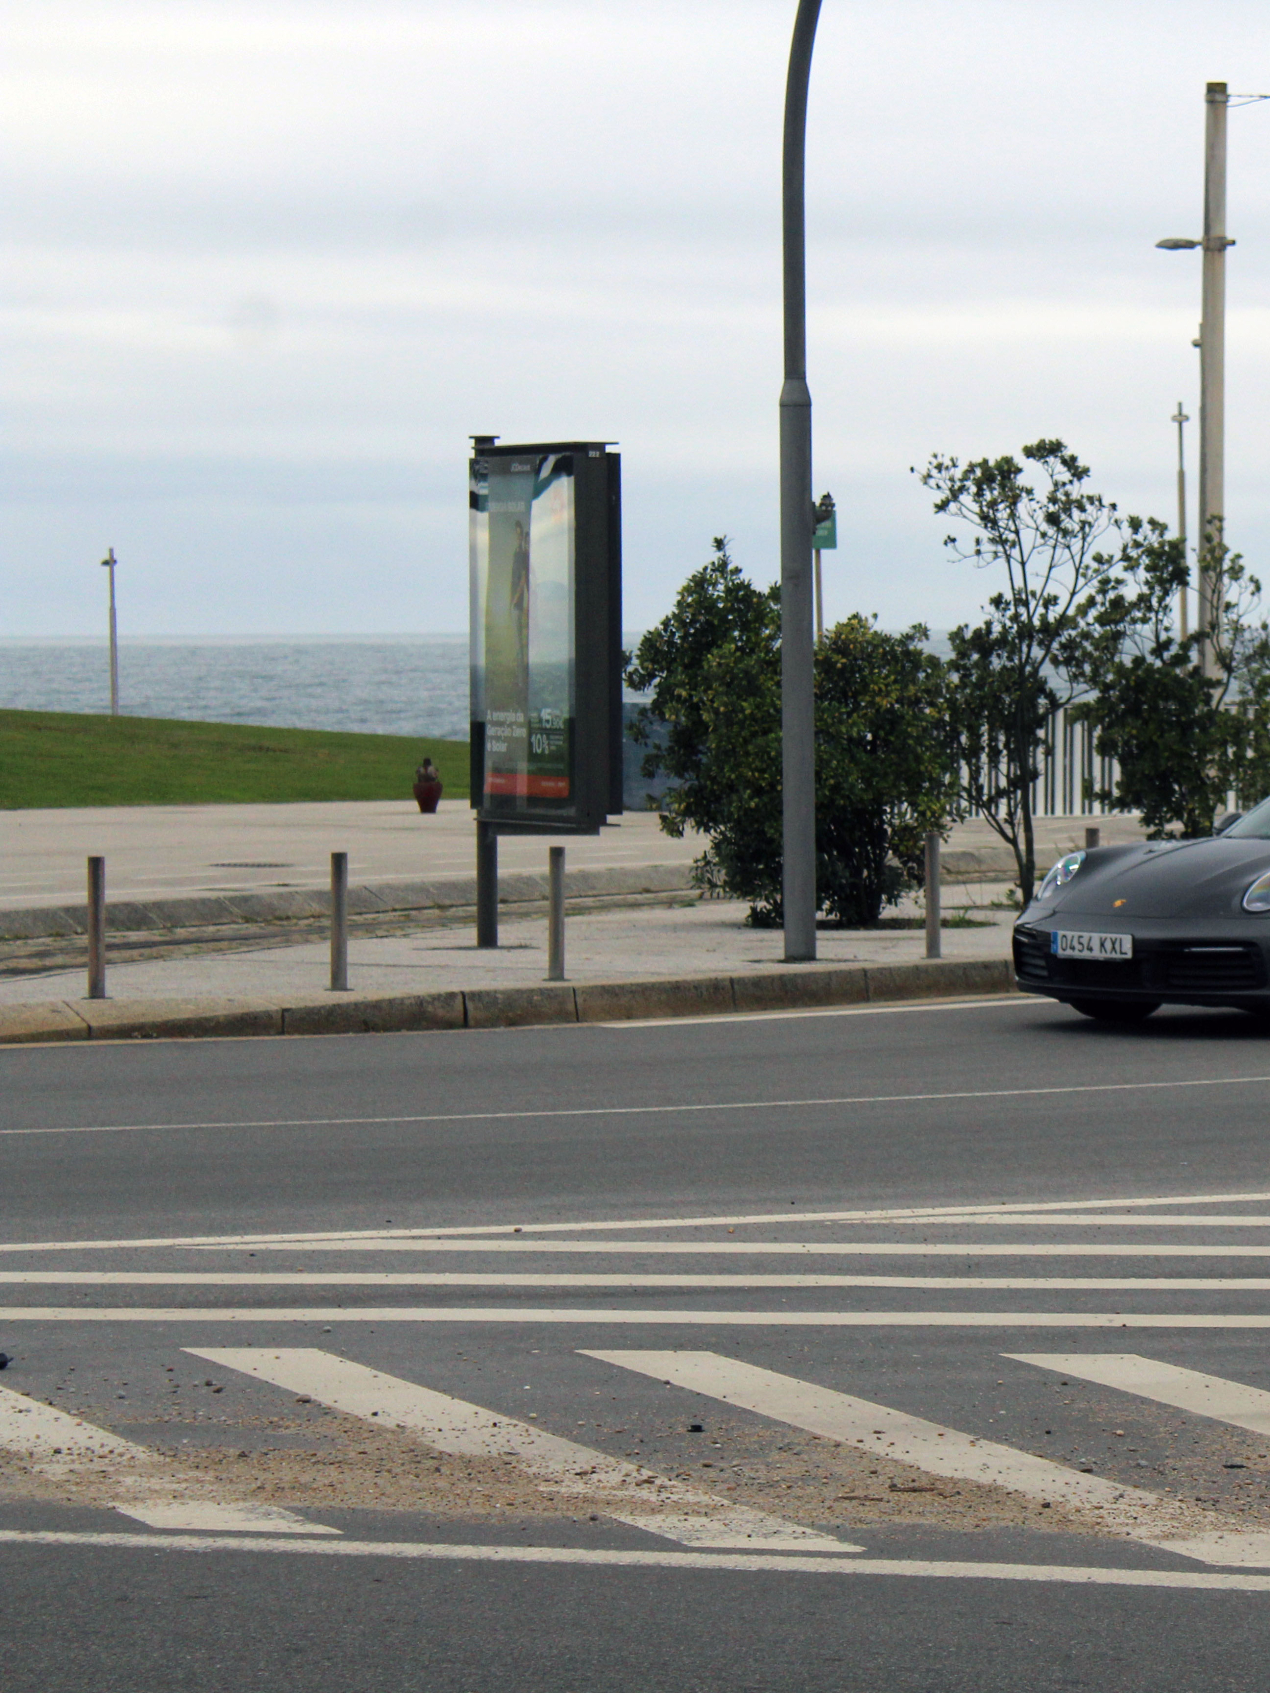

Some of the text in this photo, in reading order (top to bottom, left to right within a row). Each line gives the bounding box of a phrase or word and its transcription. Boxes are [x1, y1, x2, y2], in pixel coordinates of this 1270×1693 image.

[531, 733, 549, 754] 10%
[1061, 934, 1128, 955] 0454 KXL
